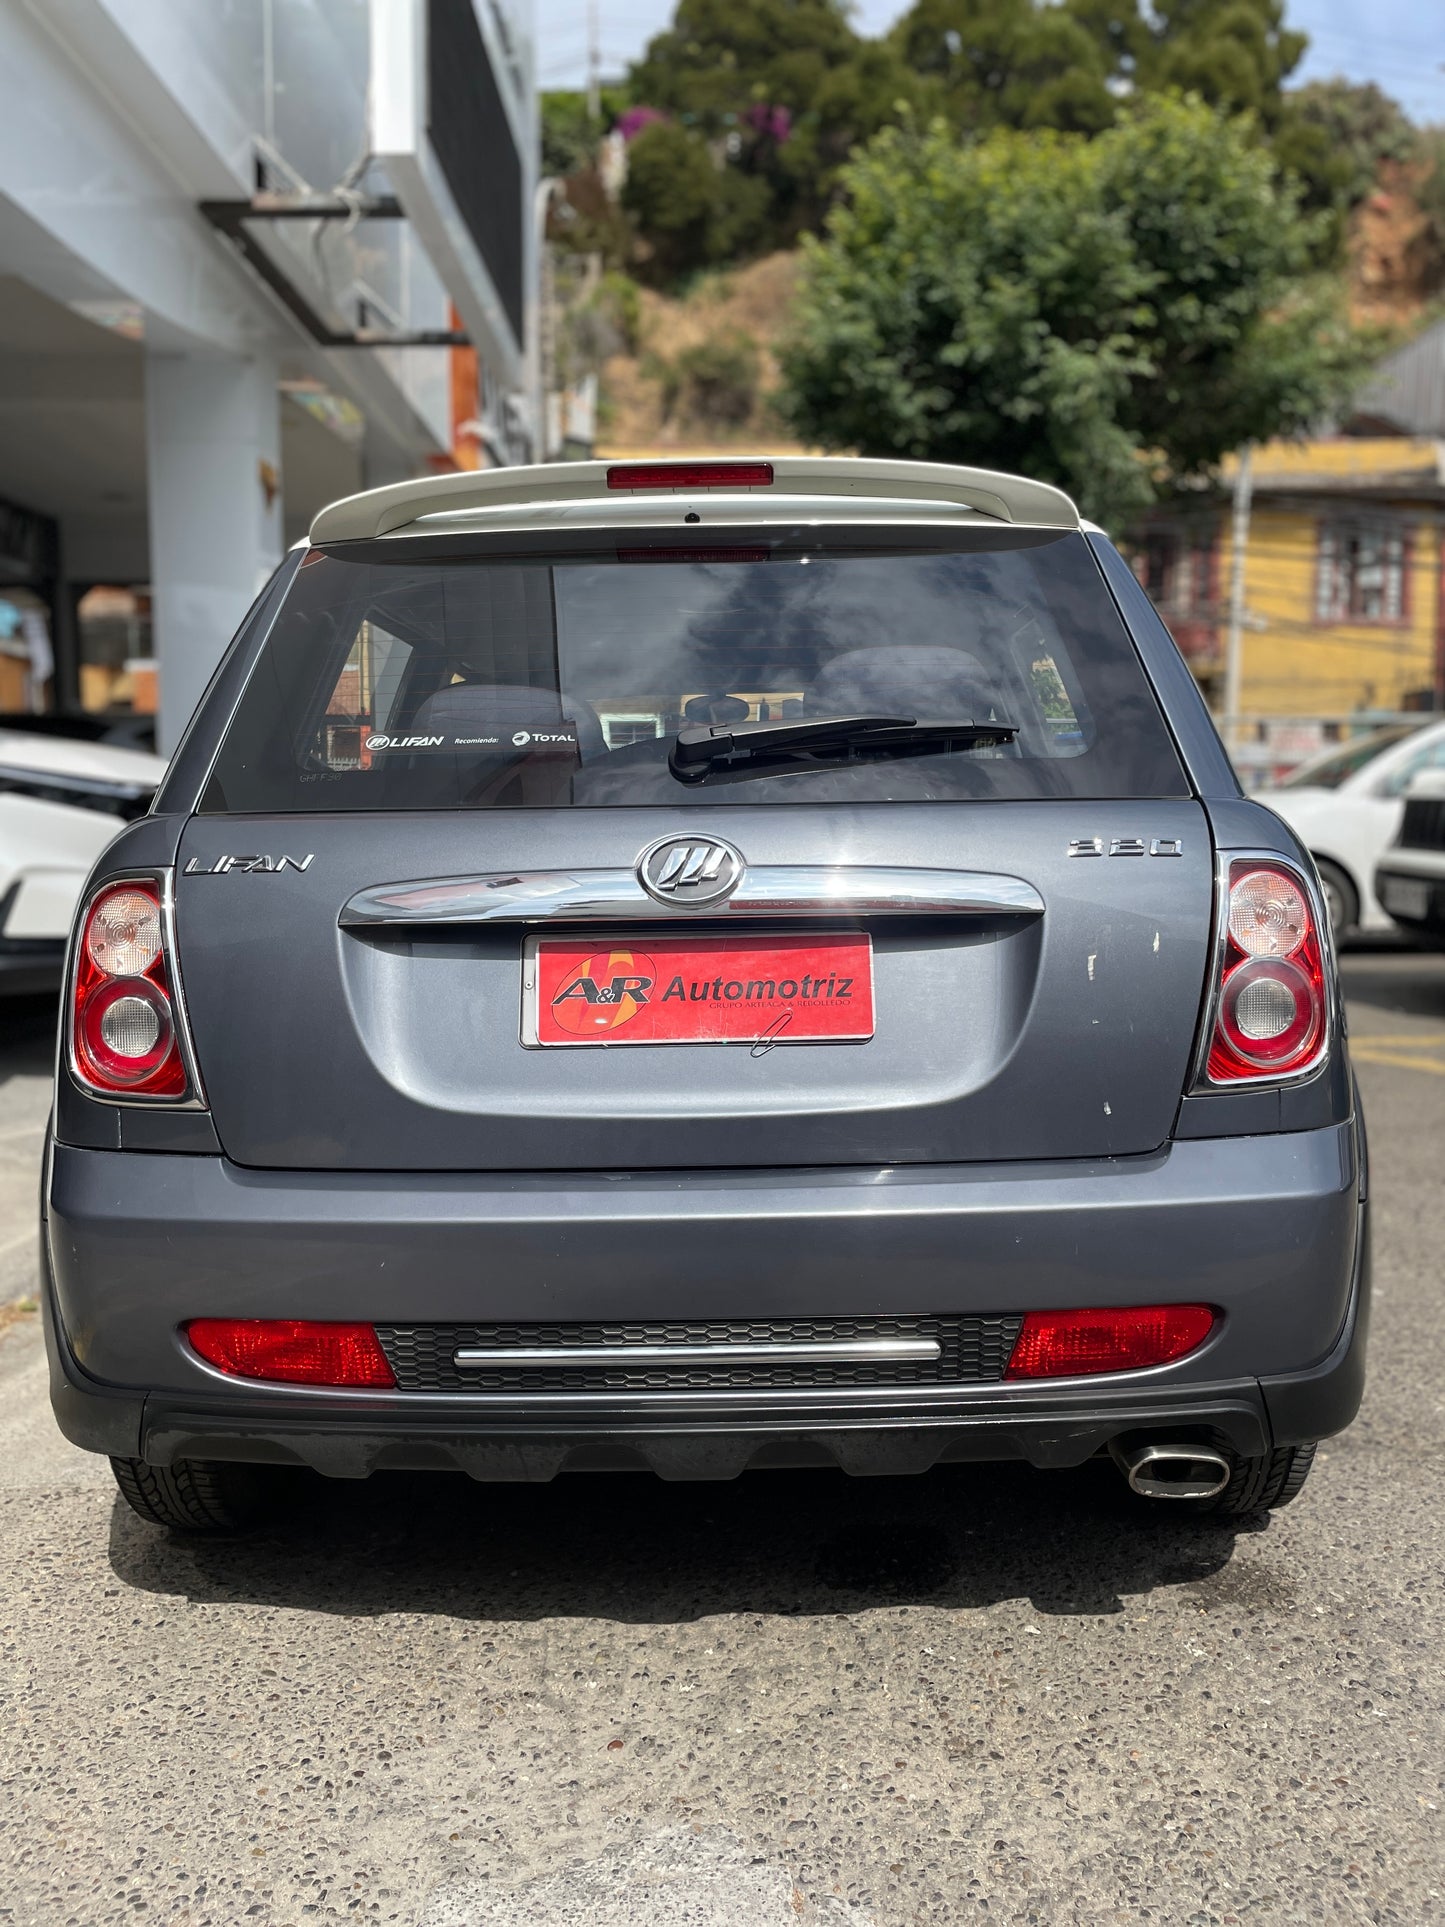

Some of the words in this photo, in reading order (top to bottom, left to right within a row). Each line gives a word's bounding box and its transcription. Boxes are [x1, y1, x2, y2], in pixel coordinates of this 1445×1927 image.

[389, 736, 444, 748] LIFAN
[532, 733, 576, 742] TOTAL
[1067, 837, 1183, 857] 320
[183, 854, 315, 876] LIFAN
[551, 976, 654, 1006] A&R
[661, 973, 854, 1002] Automotriz
[797, 999, 851, 1008] REBOLLEDO
